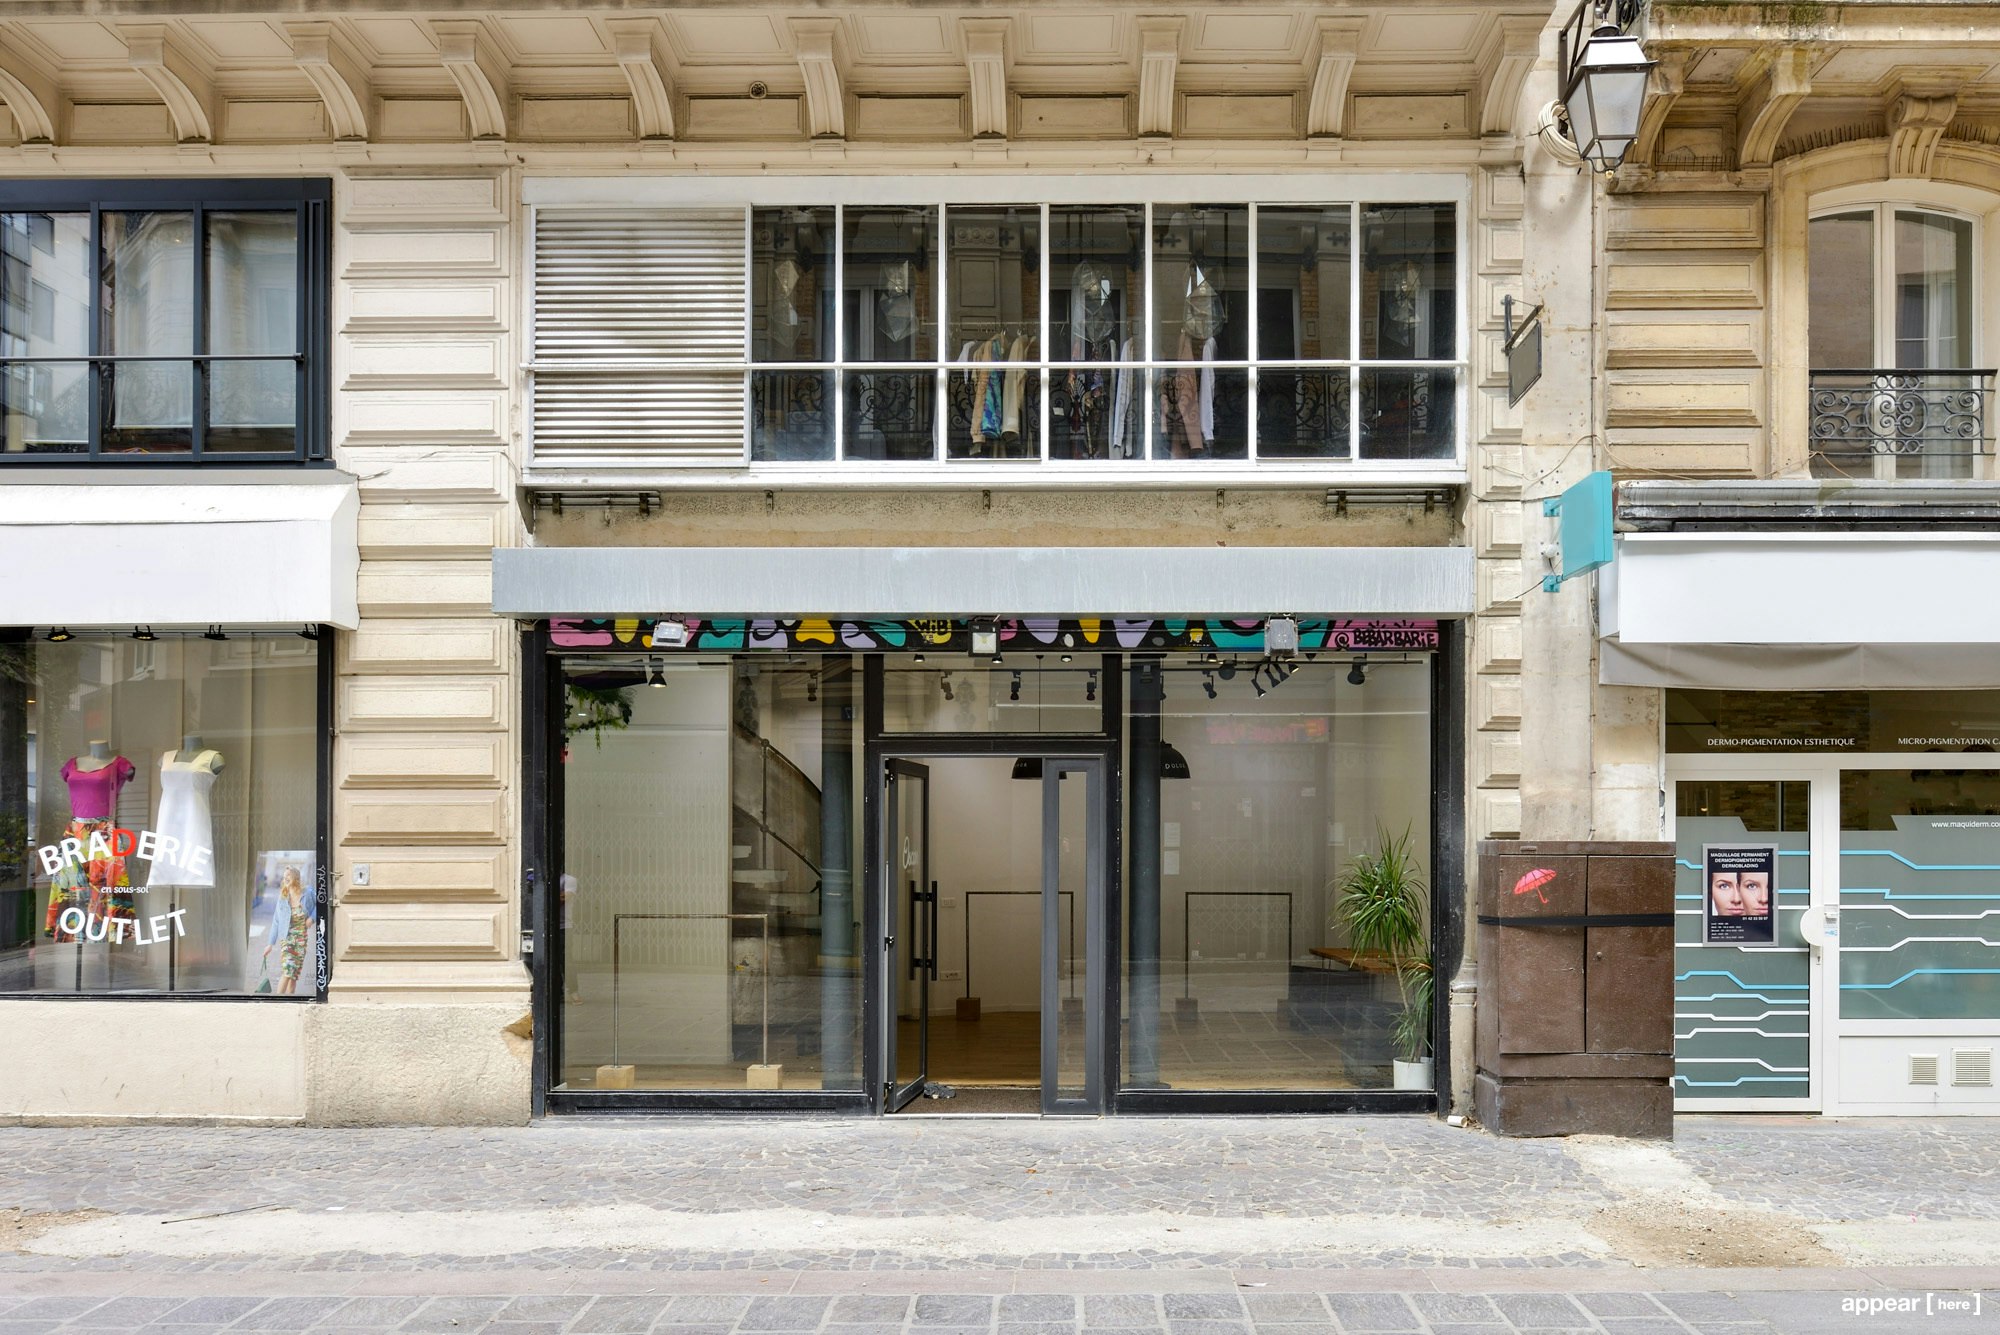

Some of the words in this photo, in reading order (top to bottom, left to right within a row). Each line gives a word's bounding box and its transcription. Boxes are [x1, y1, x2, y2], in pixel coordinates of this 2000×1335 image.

[1707, 738, 1803, 746] DERMO-PIGMENTATION
[1804, 738, 1855, 746] ESTHETIQUE
[1898, 737, 1990, 745] MICRO-PIGMENTATION
[1992, 737, 2000, 745] C
[1931, 820, 2000, 829] www.maquiderm.co
[38, 828, 212, 876] BRADERIE
[101, 886, 112, 894] en
[114, 885, 149, 894] sous-sol
[60, 907, 187, 946] OUTLET
